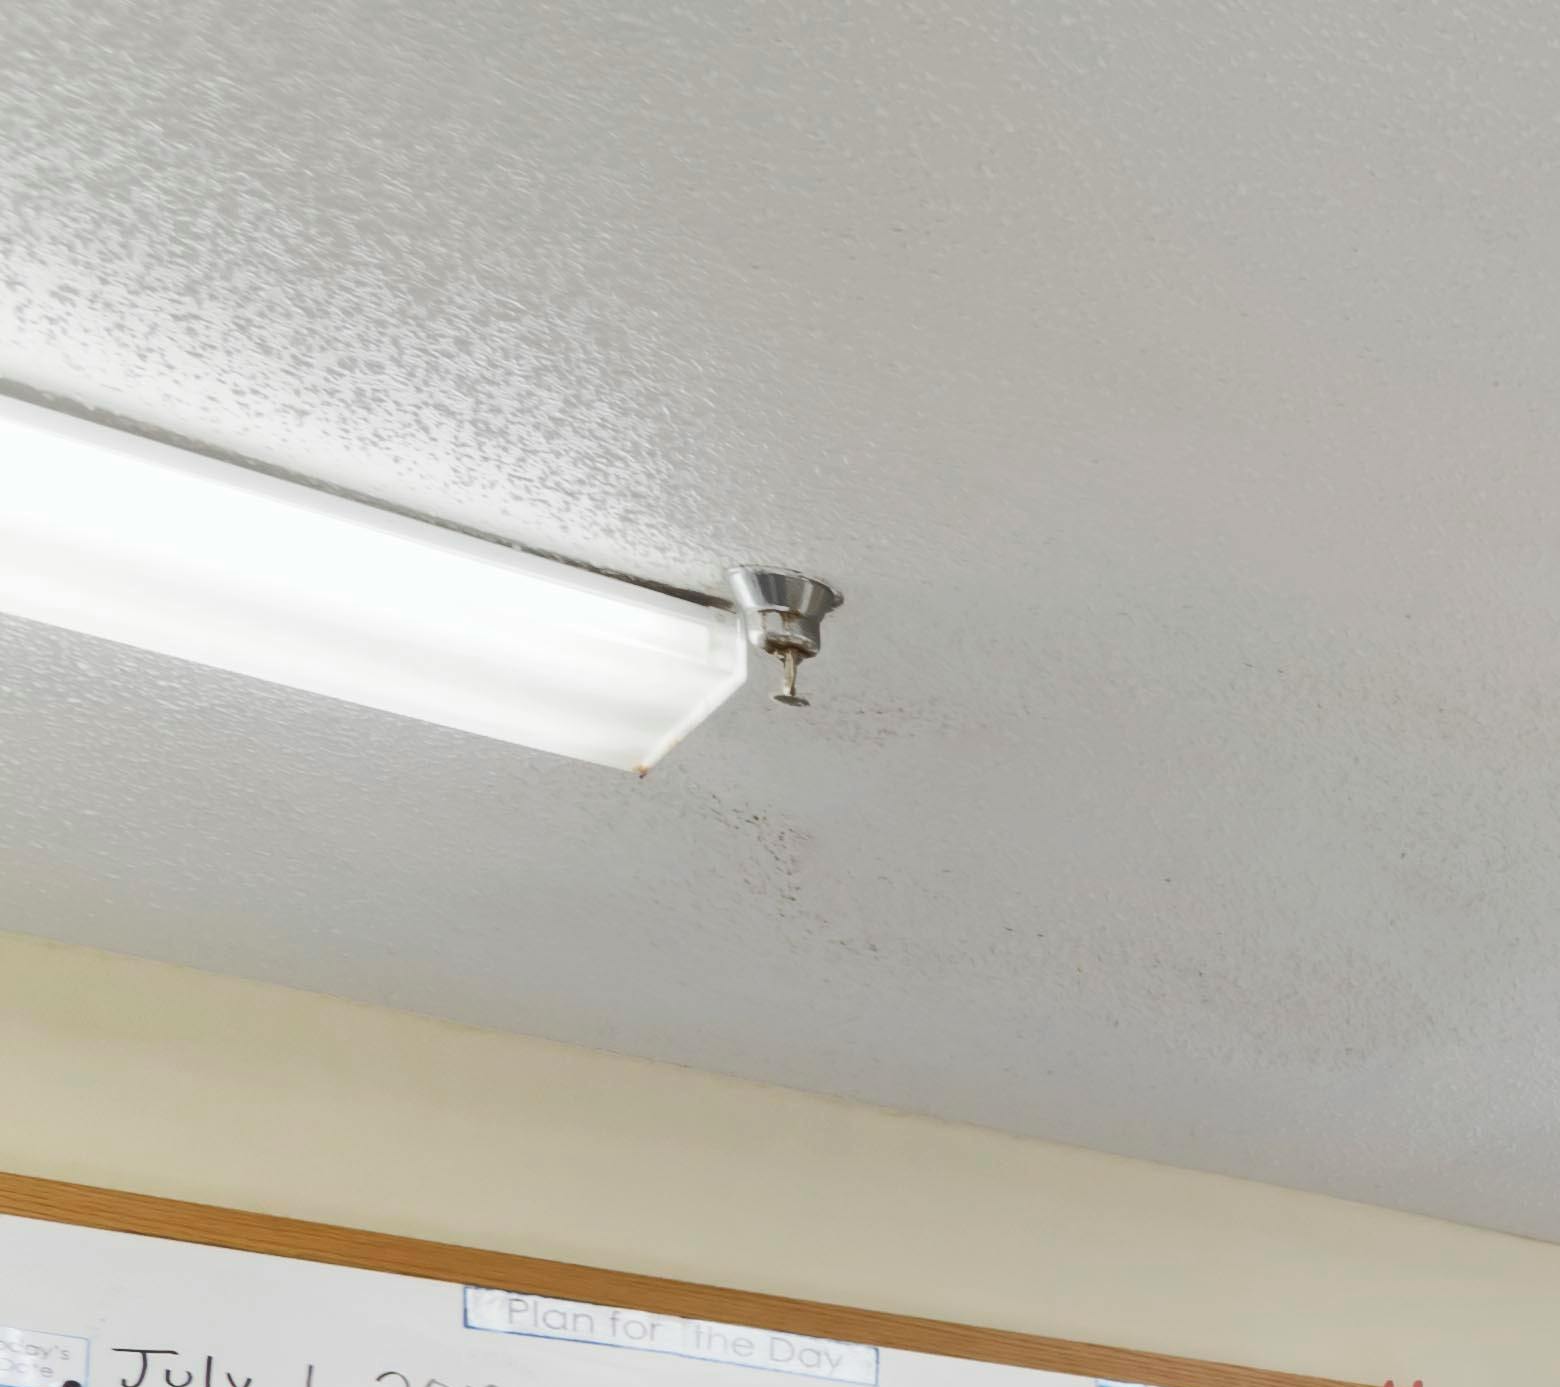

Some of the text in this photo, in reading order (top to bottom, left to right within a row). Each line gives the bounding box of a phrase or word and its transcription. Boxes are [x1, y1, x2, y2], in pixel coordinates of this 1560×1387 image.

[508, 1298, 842, 1375] Plan for the Day
